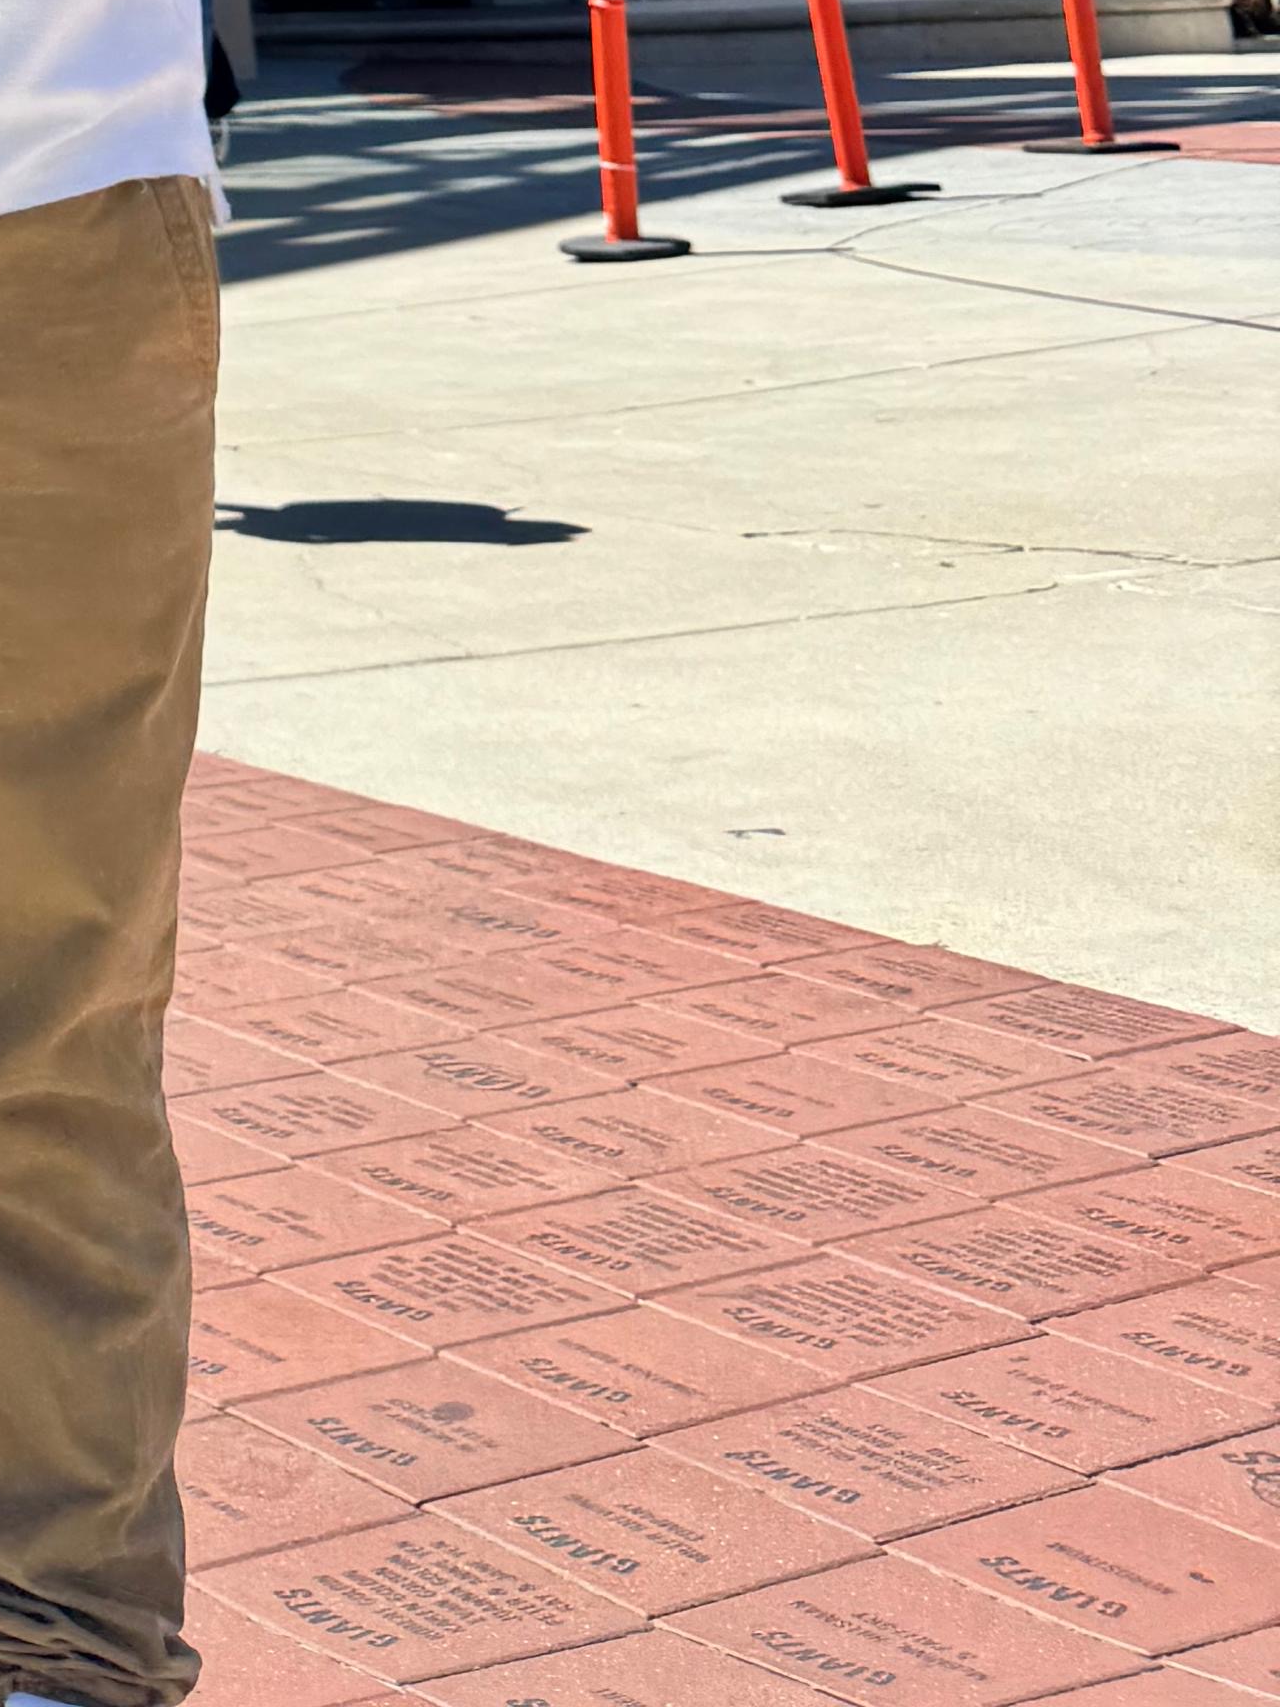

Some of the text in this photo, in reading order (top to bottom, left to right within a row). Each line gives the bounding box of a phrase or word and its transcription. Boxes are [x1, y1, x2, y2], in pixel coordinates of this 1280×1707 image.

[530, 1124, 624, 1156] GIANTS
[873, 1143, 975, 1177] GIANTS
[358, 1165, 452, 1200] GIANTS
[704, 1185, 804, 1221] GIANTS
[1073, 1205, 1189, 1244] GIANTS
[528, 1231, 631, 1271] GIANTS
[899, 1251, 1012, 1292] GIANTS
[331, 1278, 431, 1320] GIANTS
[720, 1304, 835, 1349] GIANTS
[1120, 1329, 1249, 1376] GIANTS
[517, 1355, 628, 1403] GIANTS
[939, 1388, 1066, 1438] GIANTS
[308, 1415, 416, 1465] GIANTS
[728, 1447, 859, 1503] GIANTS
[511, 1512, 639, 1574] GIANTS
[977, 1552, 1124, 1617] GIANTS
[274, 1585, 394, 1648] GIANTS
[756, 1623, 891, 1688] GIANTS
